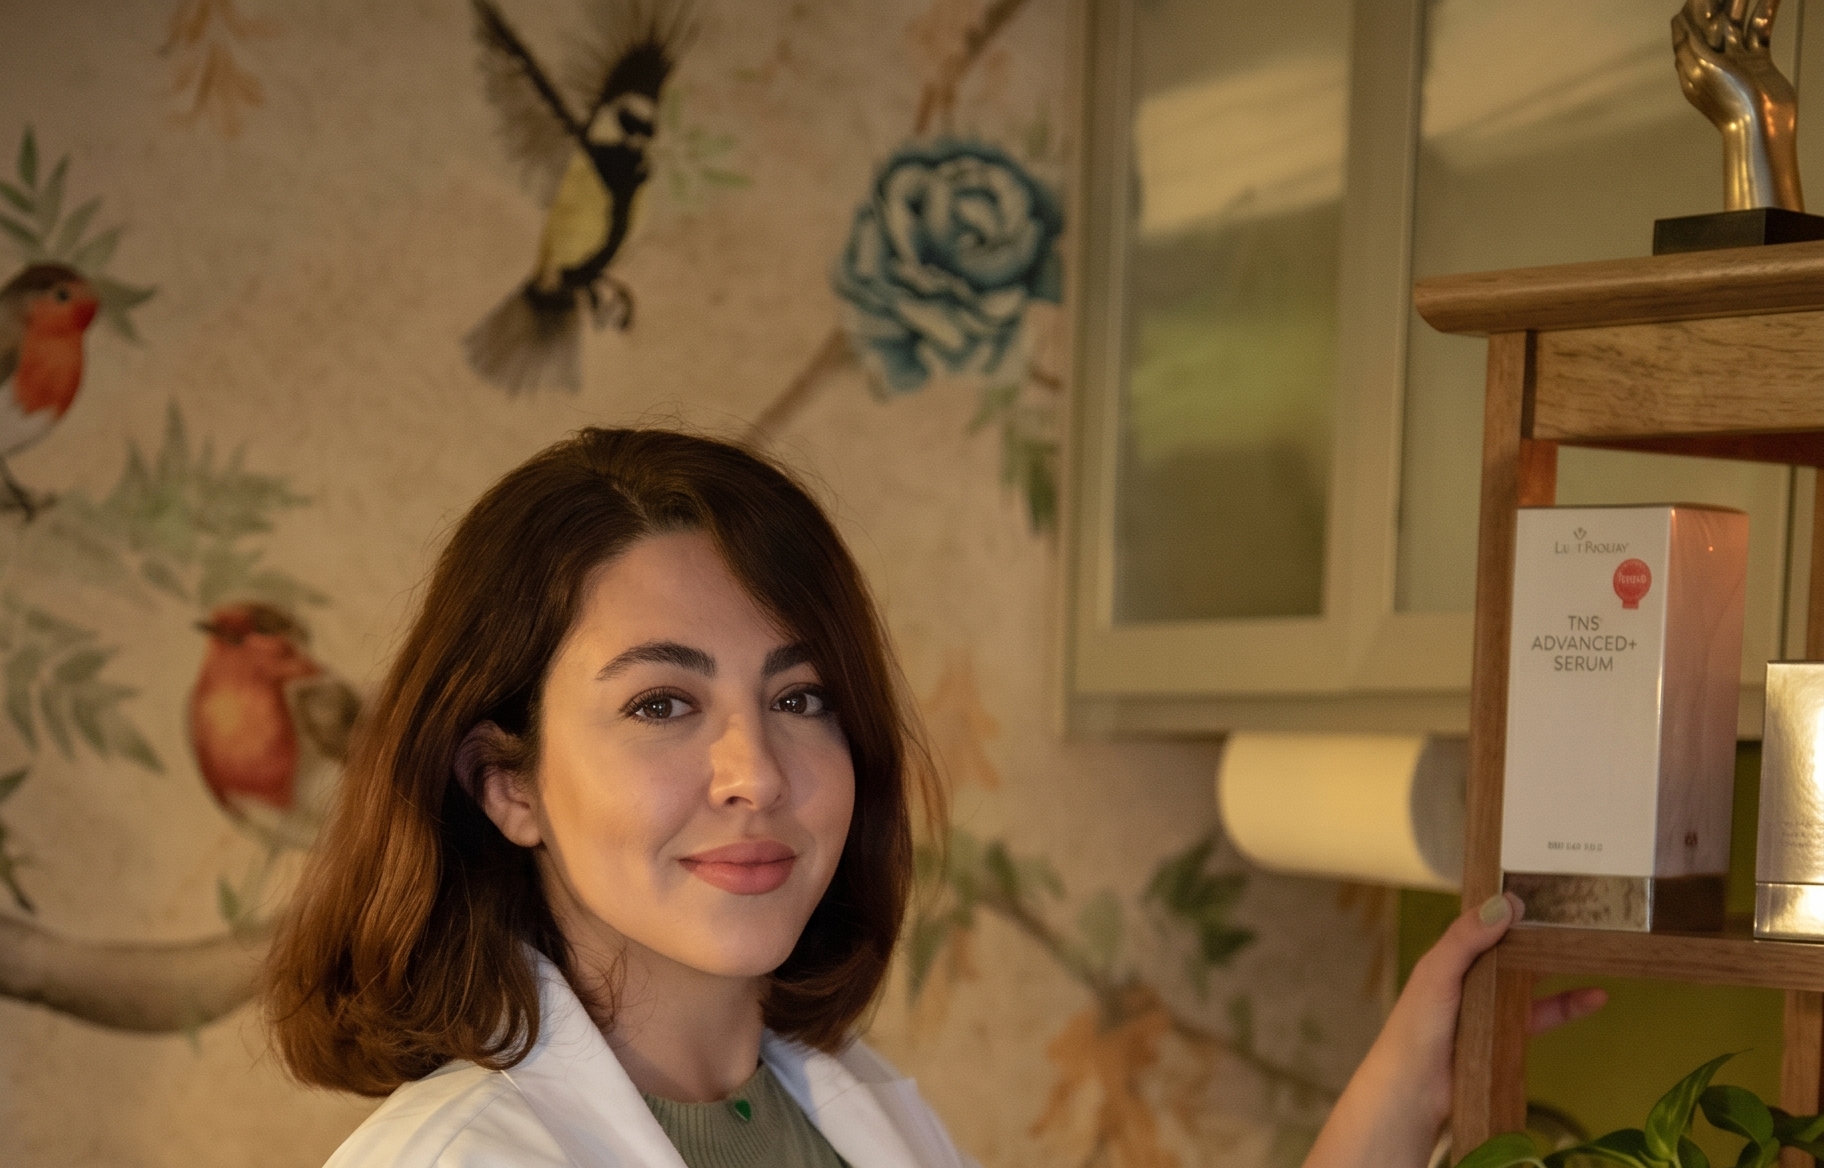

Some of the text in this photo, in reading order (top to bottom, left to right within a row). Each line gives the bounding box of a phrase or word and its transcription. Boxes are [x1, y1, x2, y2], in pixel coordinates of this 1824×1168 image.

[1568, 615, 1600, 631] TNS
[1532, 635, 1637, 652] ADVANCED+
[1553, 655, 1614, 672] SERUM
